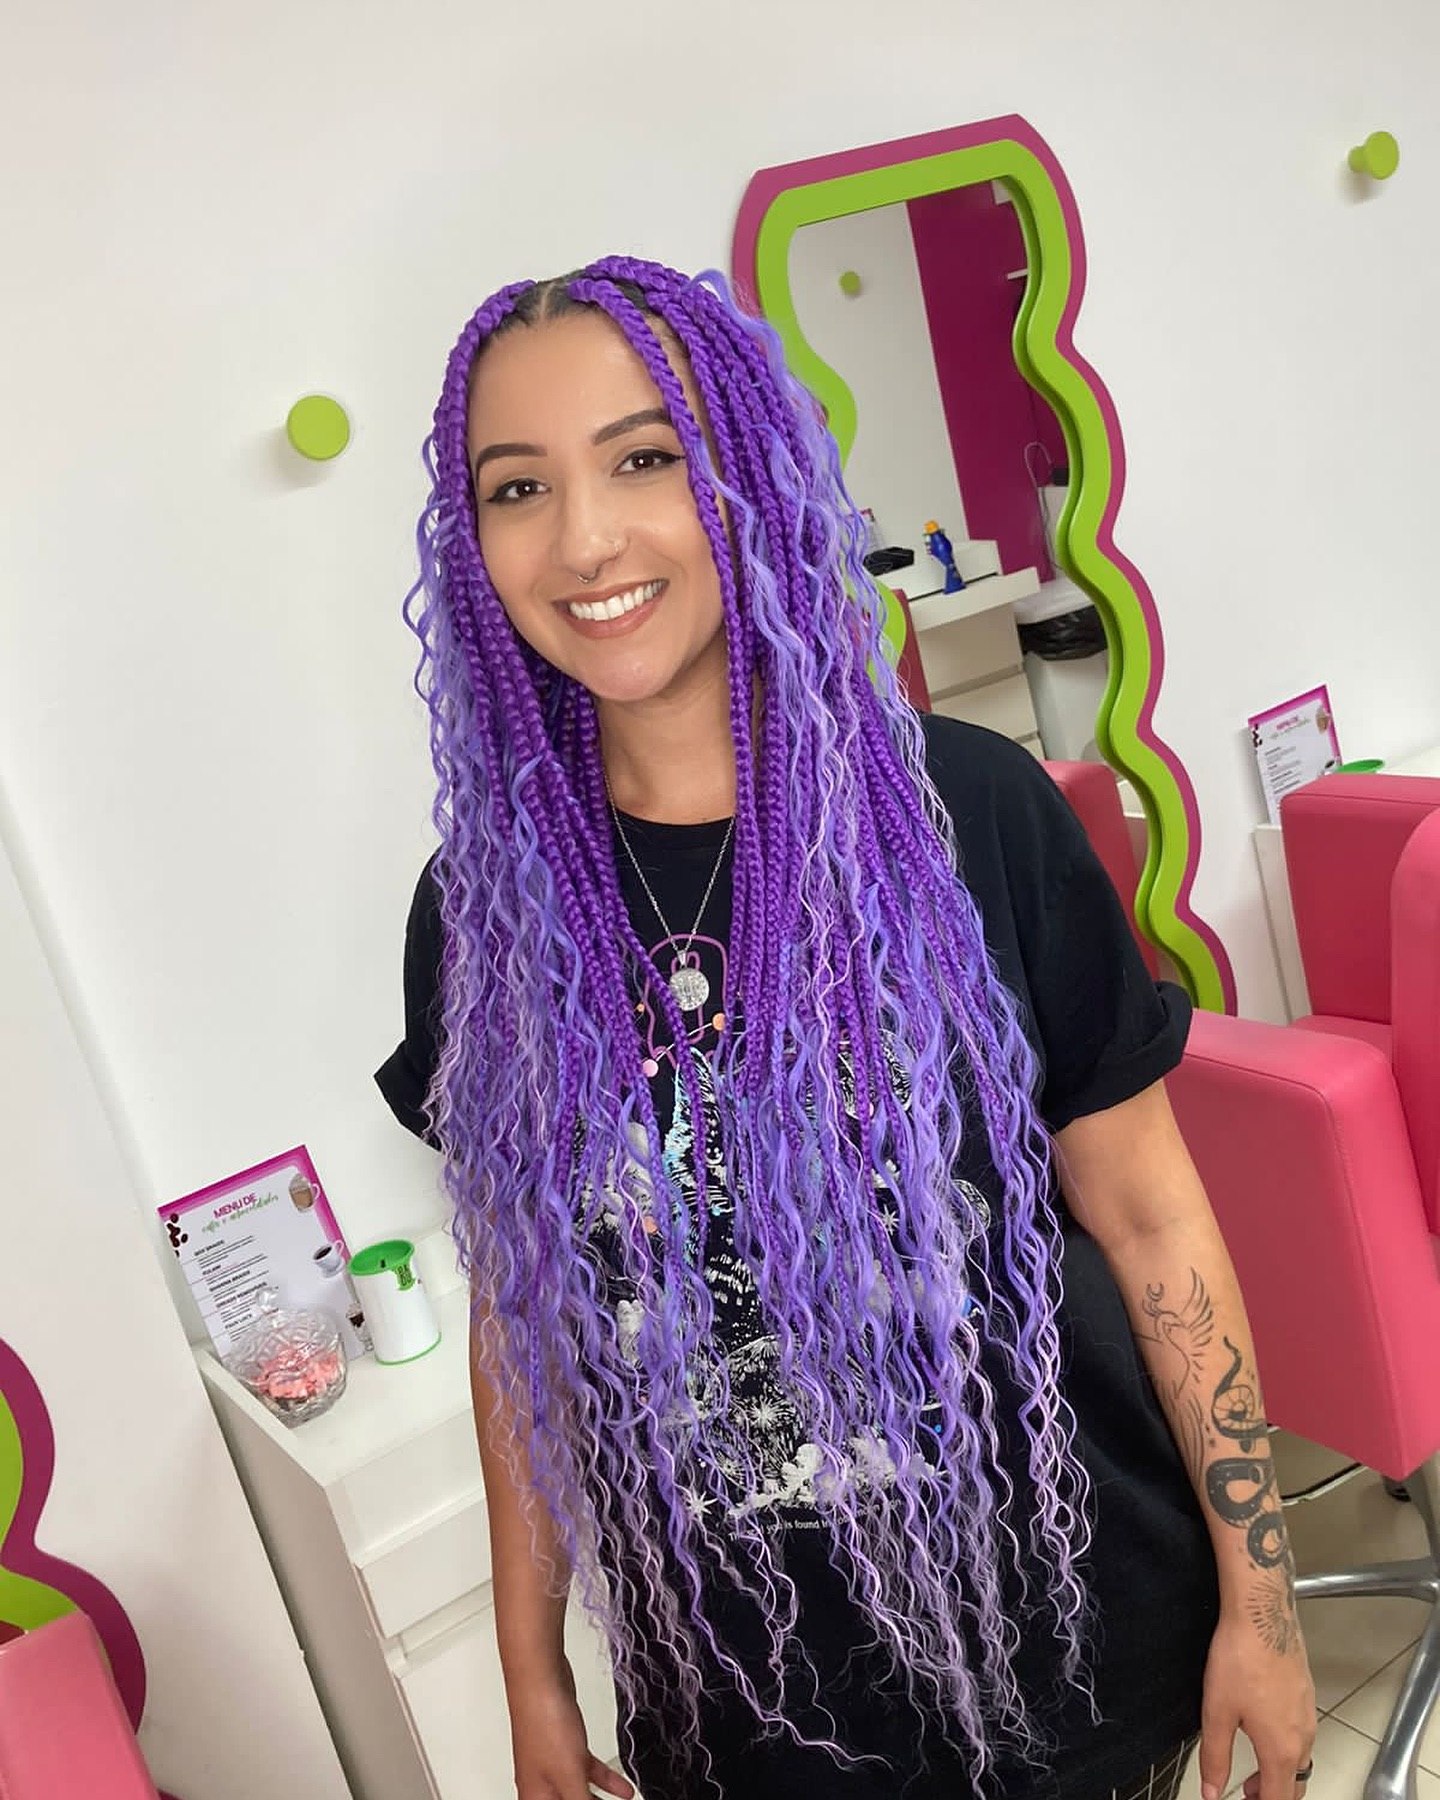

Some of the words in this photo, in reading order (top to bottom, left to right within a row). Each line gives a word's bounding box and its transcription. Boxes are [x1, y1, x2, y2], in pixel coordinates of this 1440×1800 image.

[213, 1199, 242, 1218] MENU
[243, 1193, 256, 1205] DE
[794, 1519, 819, 1529] found
